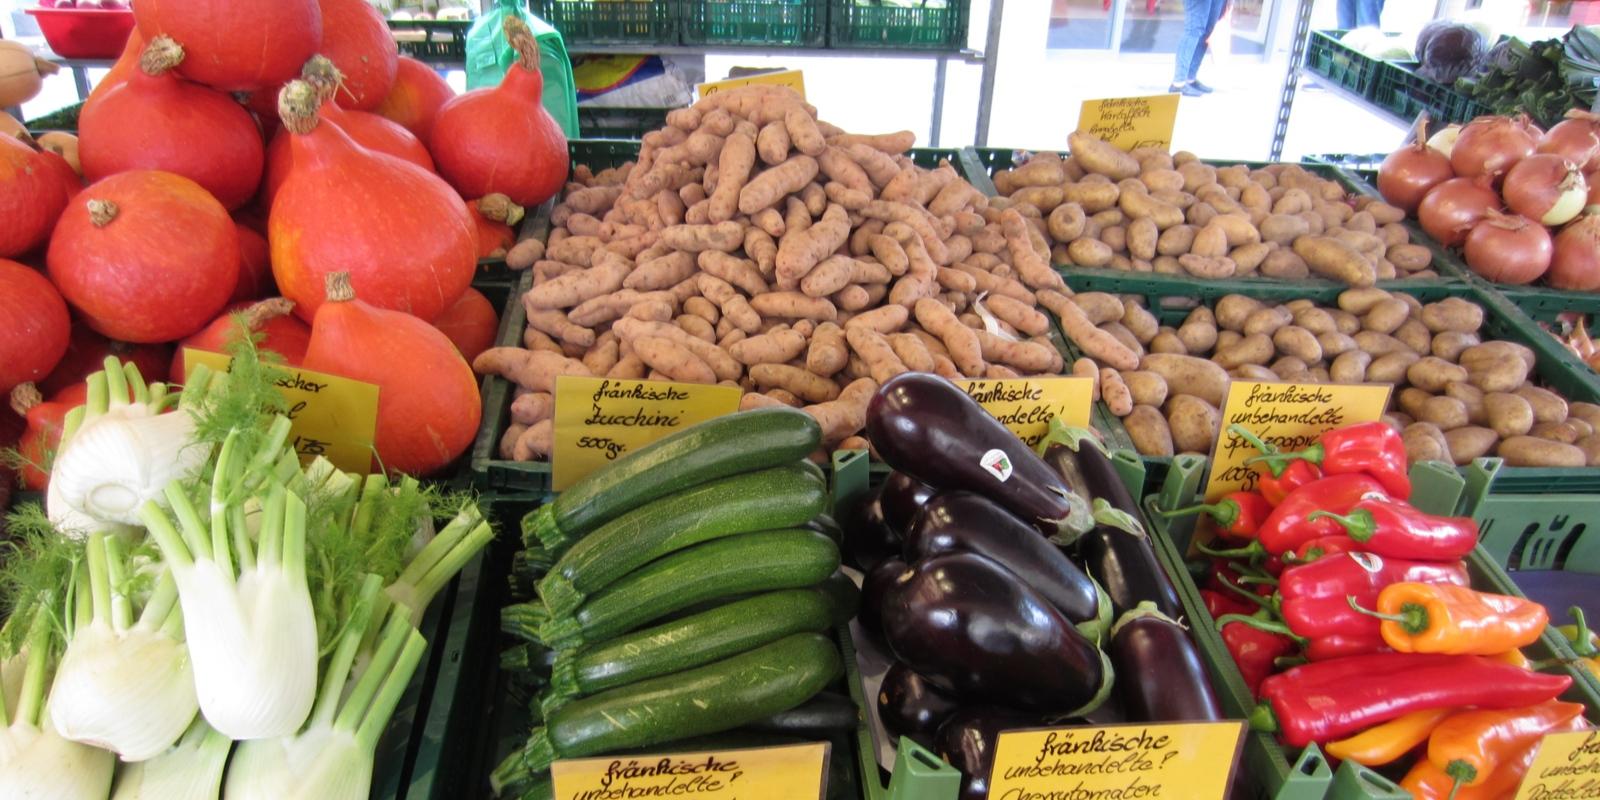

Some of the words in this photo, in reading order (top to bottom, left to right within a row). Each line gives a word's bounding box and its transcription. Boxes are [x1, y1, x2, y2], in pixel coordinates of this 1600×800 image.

[593, 380, 690, 401] fränkische
[1245, 383, 1334, 407] fränkische
[585, 403, 685, 427] Zucchini
[1231, 406, 1344, 425] unbehandelte
[1035, 729, 1171, 761] fränkische
[601, 756, 740, 786] fränkische
